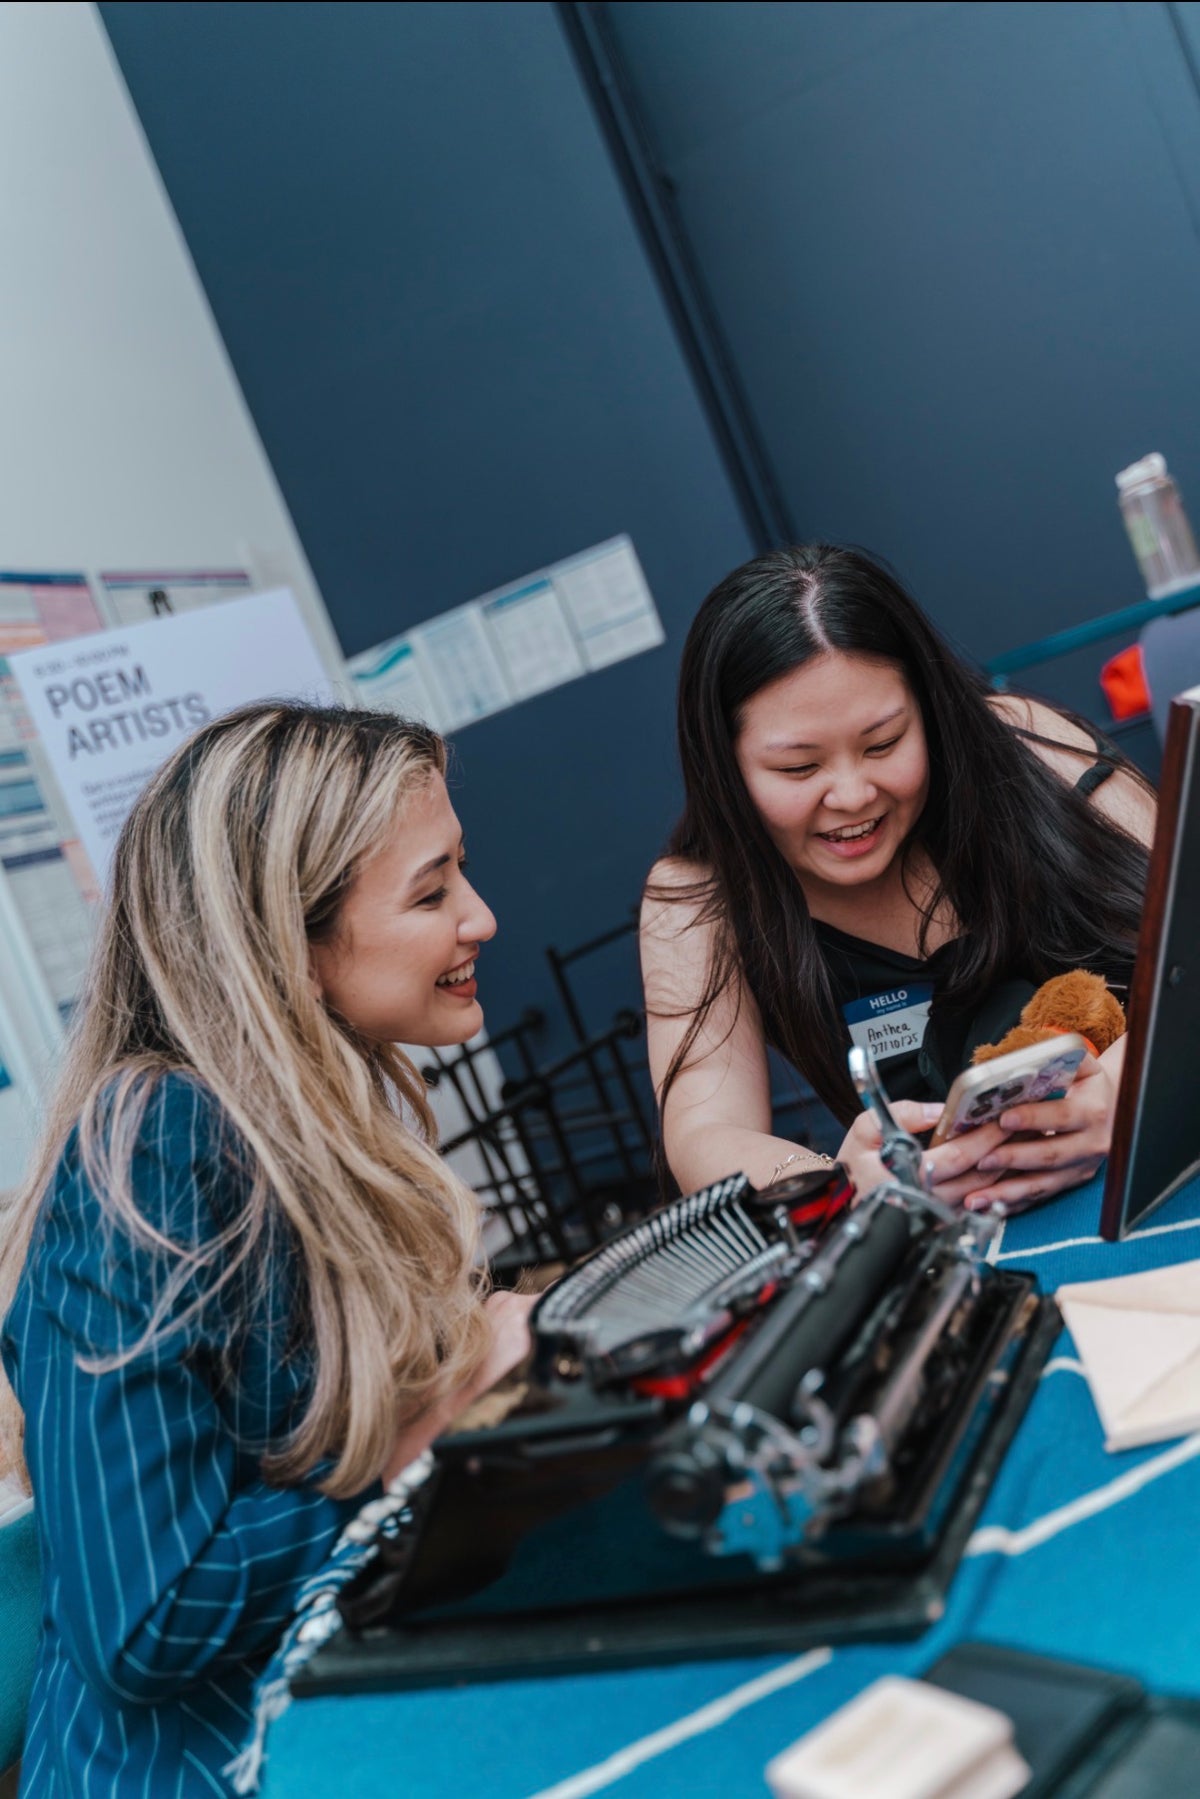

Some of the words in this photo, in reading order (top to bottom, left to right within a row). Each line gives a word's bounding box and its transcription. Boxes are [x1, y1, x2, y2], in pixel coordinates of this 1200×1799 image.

[45, 664, 151, 718] POEM
[67, 692, 210, 760] ARTISTS
[869, 990, 908, 1009] HELLO
[867, 1022, 911, 1042] Anthea
